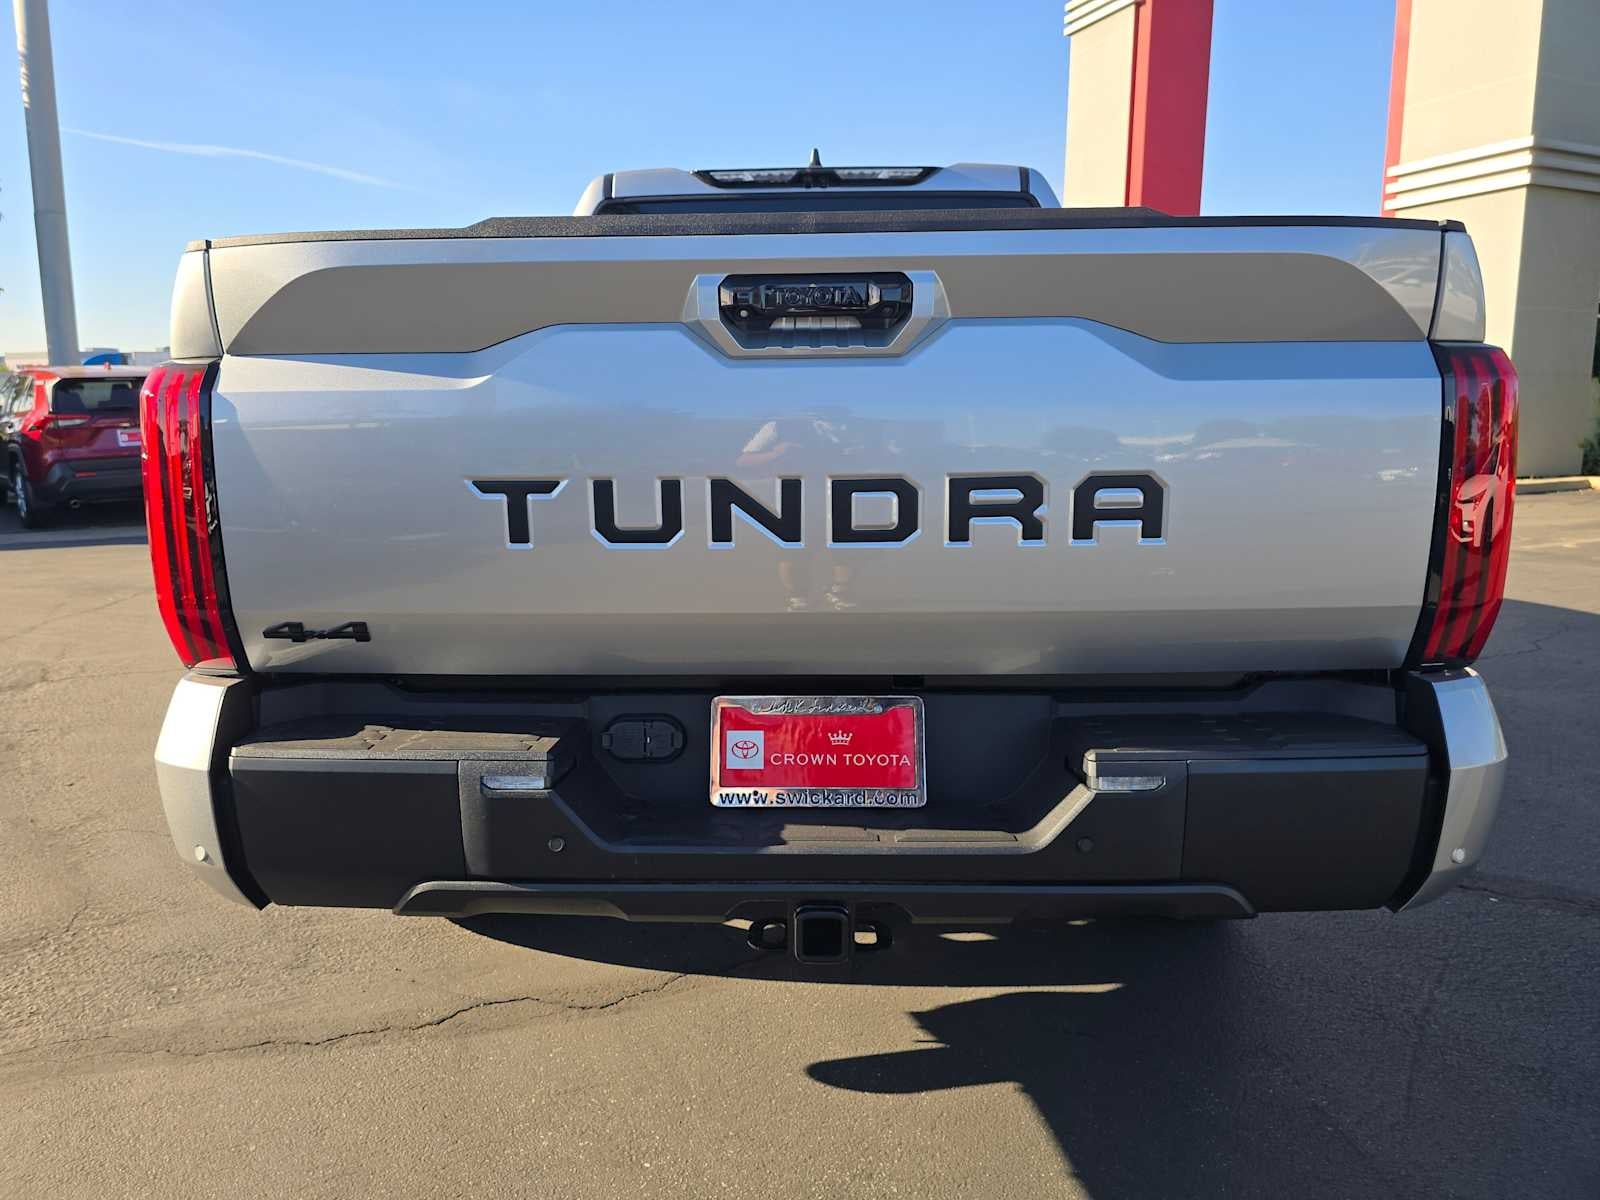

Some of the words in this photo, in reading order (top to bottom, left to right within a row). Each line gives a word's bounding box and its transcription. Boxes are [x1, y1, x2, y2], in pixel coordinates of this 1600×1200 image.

[772, 286, 860, 305] TOYOTA
[464, 471, 1170, 549] TUNDRA
[770, 753, 837, 766] CROWN
[843, 753, 911, 767] TOYOTA
[719, 789, 918, 806] www.swickard.com
